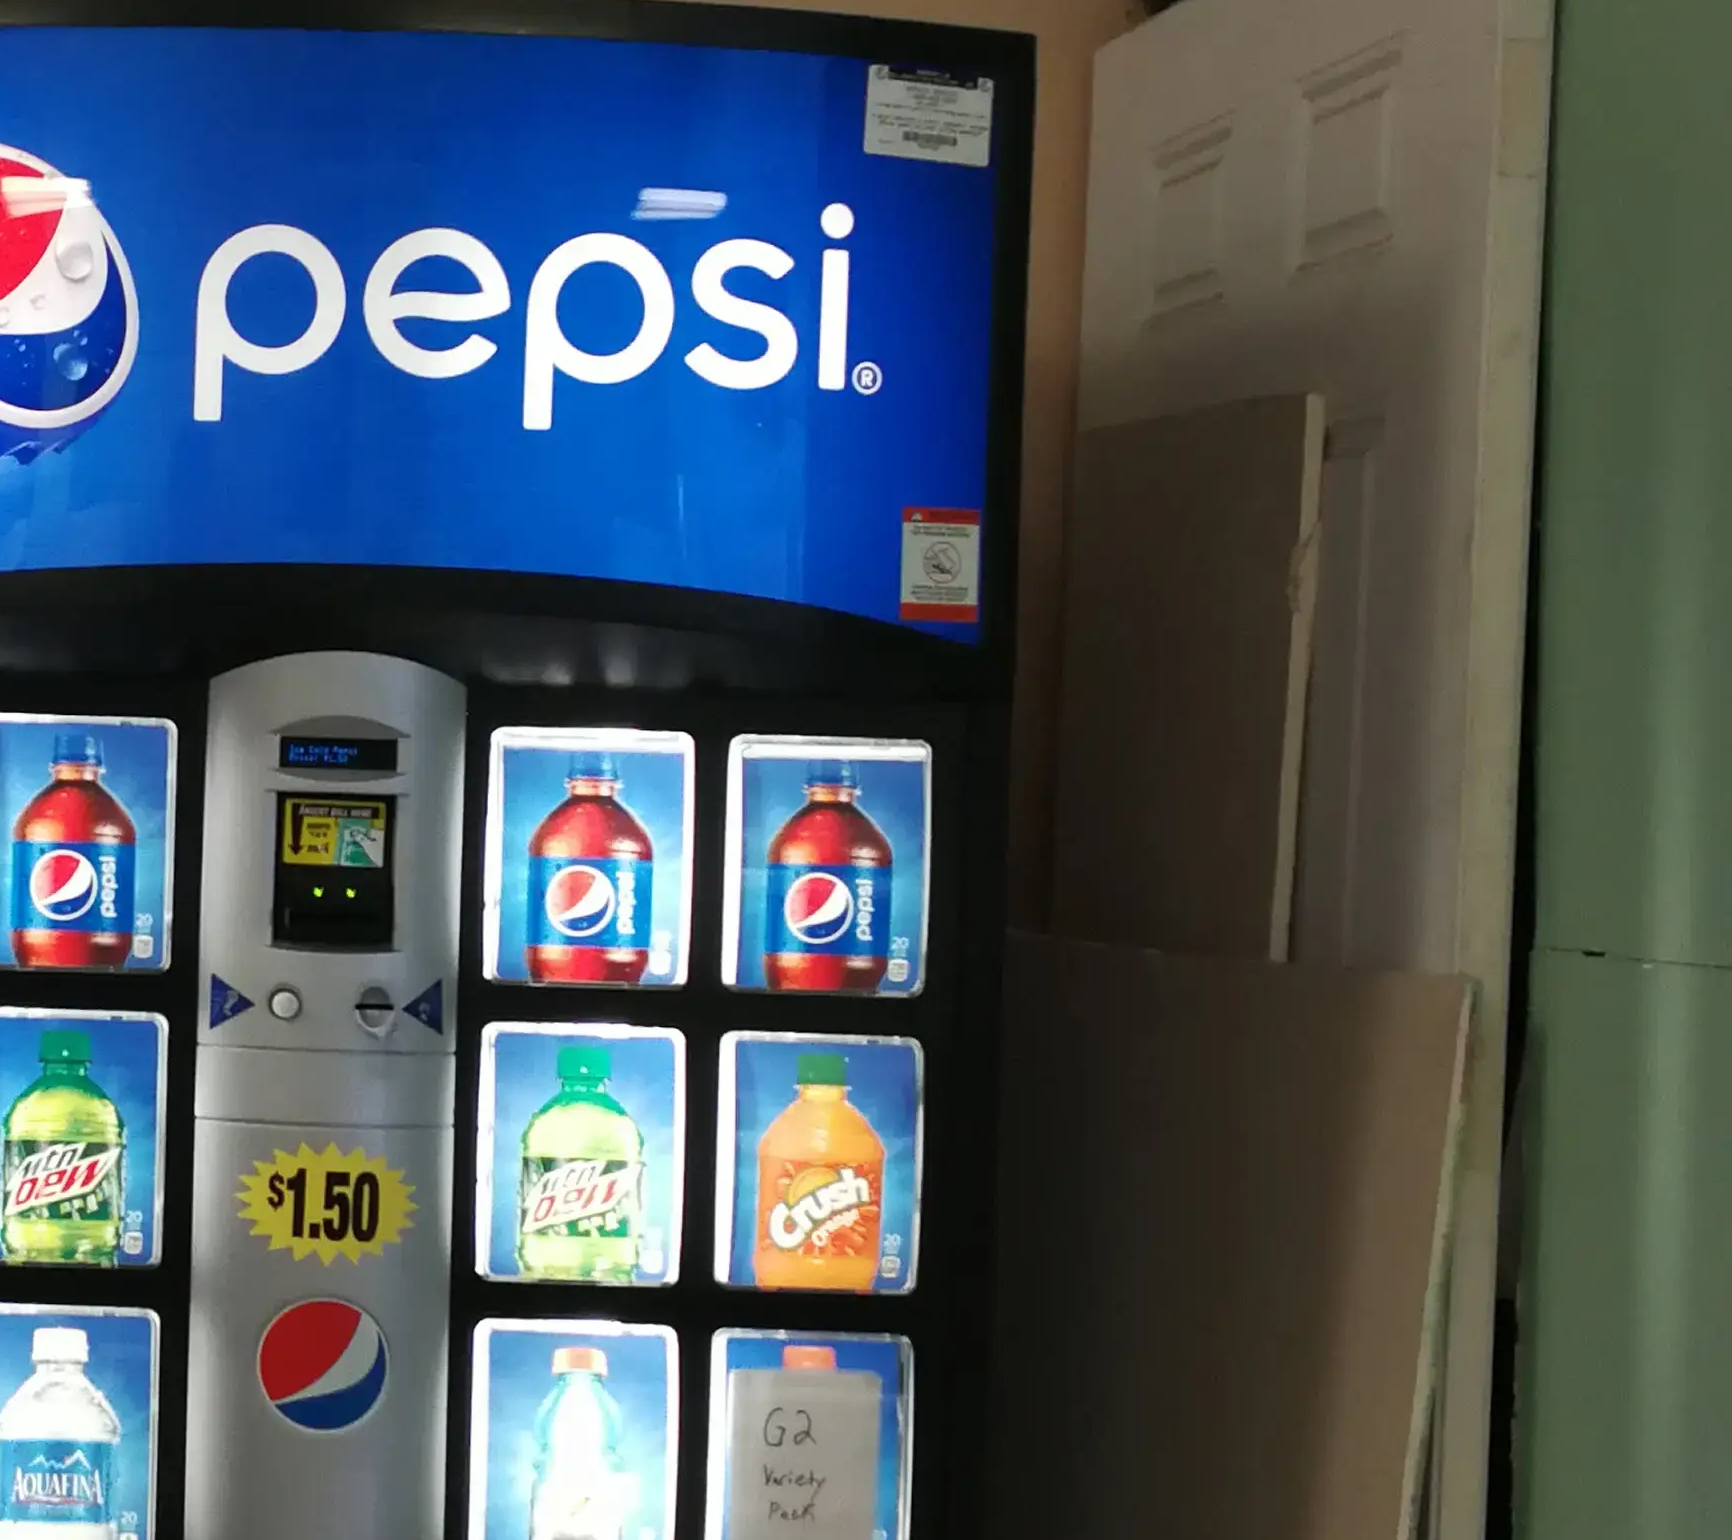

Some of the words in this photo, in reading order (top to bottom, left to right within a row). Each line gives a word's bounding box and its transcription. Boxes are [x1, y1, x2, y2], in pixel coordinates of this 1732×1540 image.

[193, 202, 856, 431] pepsi
[267, 1167, 380, 1242] $1.50
[770, 1168, 870, 1248] Crush
[763, 1407, 817, 1448] G2
[11, 1465, 105, 1505] AQUAFINA
[763, 1463, 827, 1502] Variety
